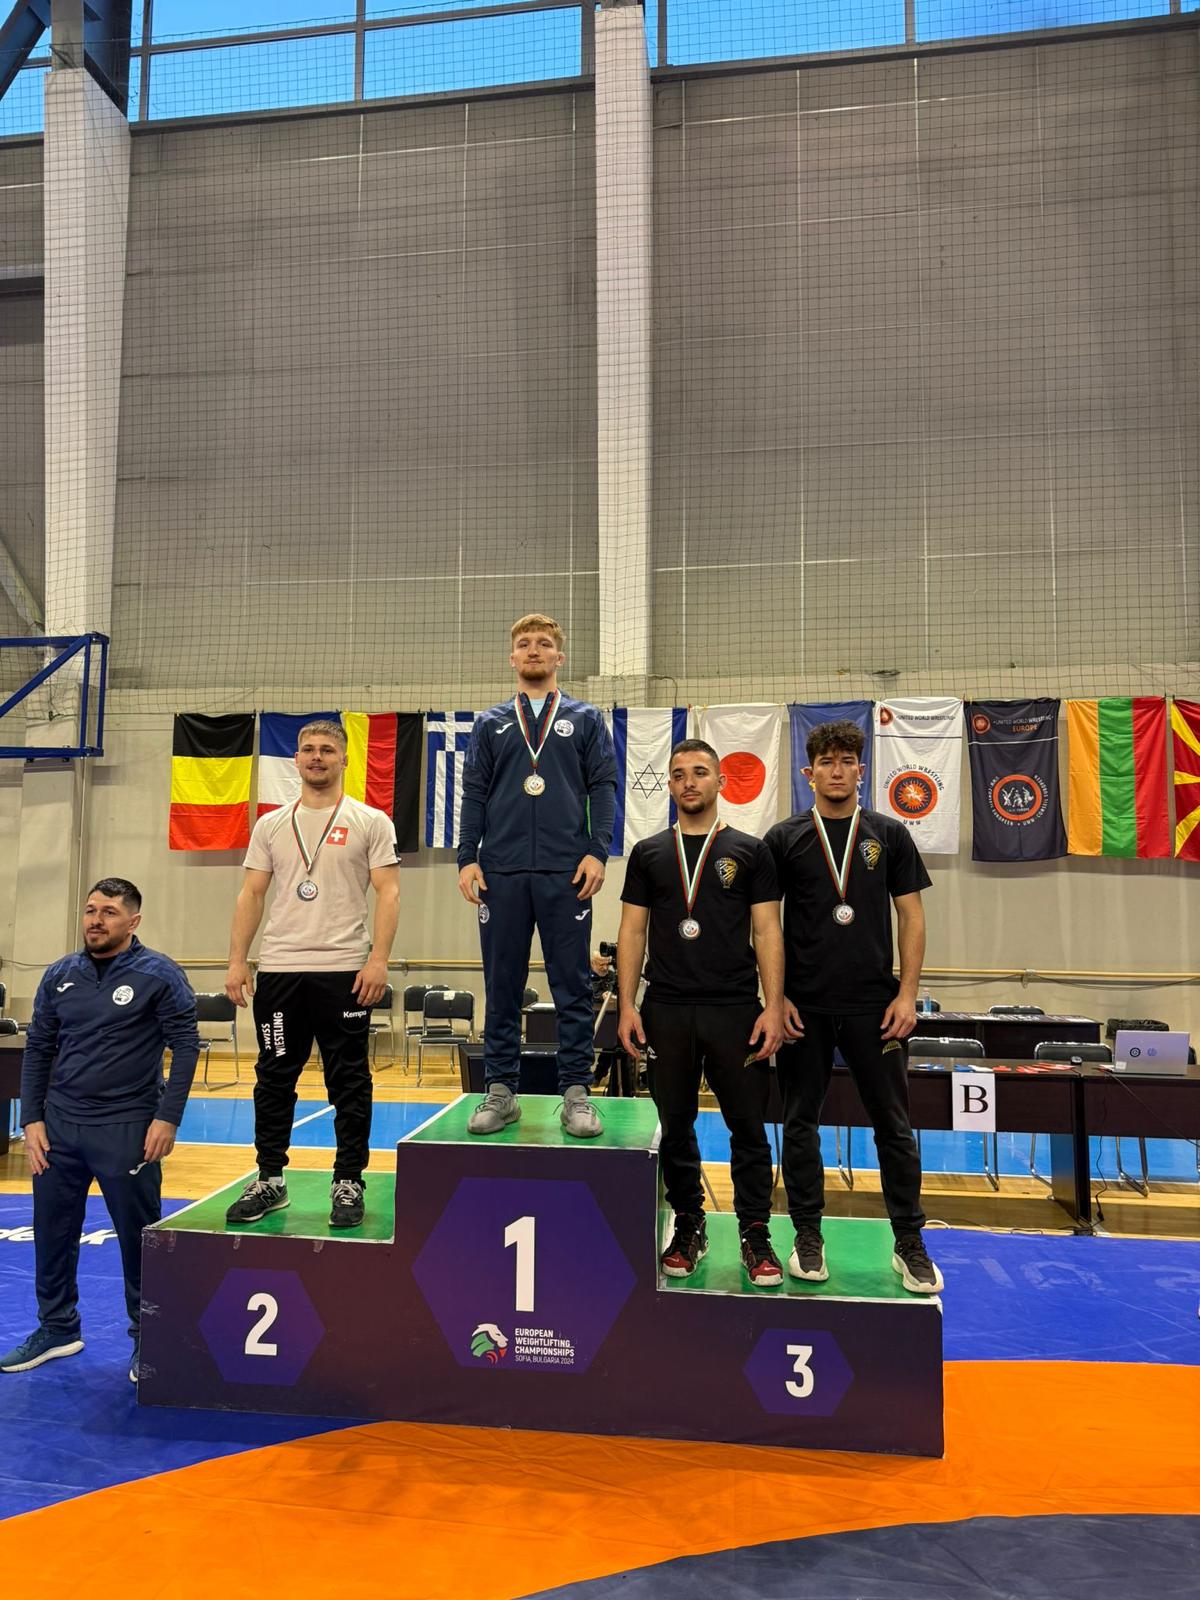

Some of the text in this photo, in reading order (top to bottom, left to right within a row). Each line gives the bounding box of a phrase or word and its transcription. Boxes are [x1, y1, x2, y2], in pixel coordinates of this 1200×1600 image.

[1012, 723, 1038, 732] EUROPE
[897, 763, 917, 773] WORLD
[918, 765, 945, 791] WRESTLING
[343, 1010, 367, 1018] Kempa
[959, 1084, 989, 1114] B
[504, 1215, 536, 1313] 1
[244, 1292, 279, 1356] 2
[514, 1327, 554, 1338] EUROPEAN
[515, 1337, 571, 1348] WEIGHTLIFTING
[514, 1345, 575, 1357] CHAMPIONSHIPS
[532, 1355, 560, 1364] BULGARIA
[560, 1357, 575, 1365] 2024
[785, 1343, 815, 1398] 3
